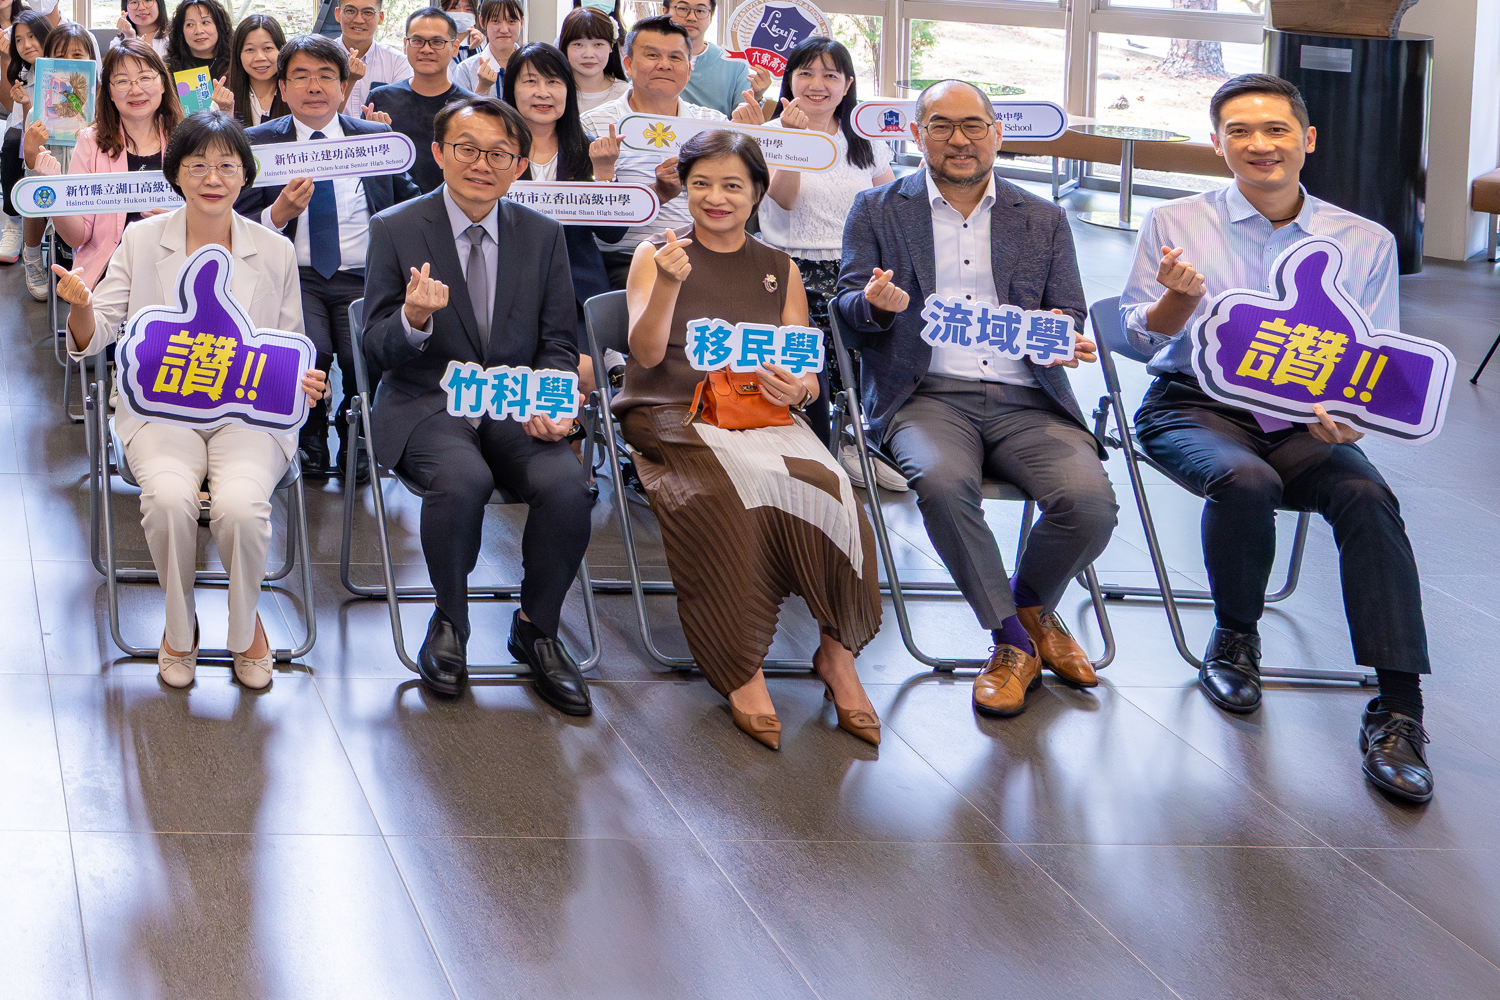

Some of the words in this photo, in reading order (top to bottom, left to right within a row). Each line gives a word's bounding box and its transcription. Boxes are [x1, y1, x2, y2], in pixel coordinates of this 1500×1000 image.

[197, 73, 210, 99] 新竹學
[1004, 123, 1032, 131] School
[274, 143, 390, 166] 新竹市立建功高級中學
[765, 151, 783, 161] High
[785, 153, 808, 163] School
[264, 169, 287, 177] Hsinchu
[288, 166, 315, 175] Municipal
[370, 159, 384, 167] High
[96, 198, 122, 206] County
[928, 299, 1071, 360] 流域學
[692, 324, 821, 374] 移民學
[446, 367, 575, 419] 竹科學
